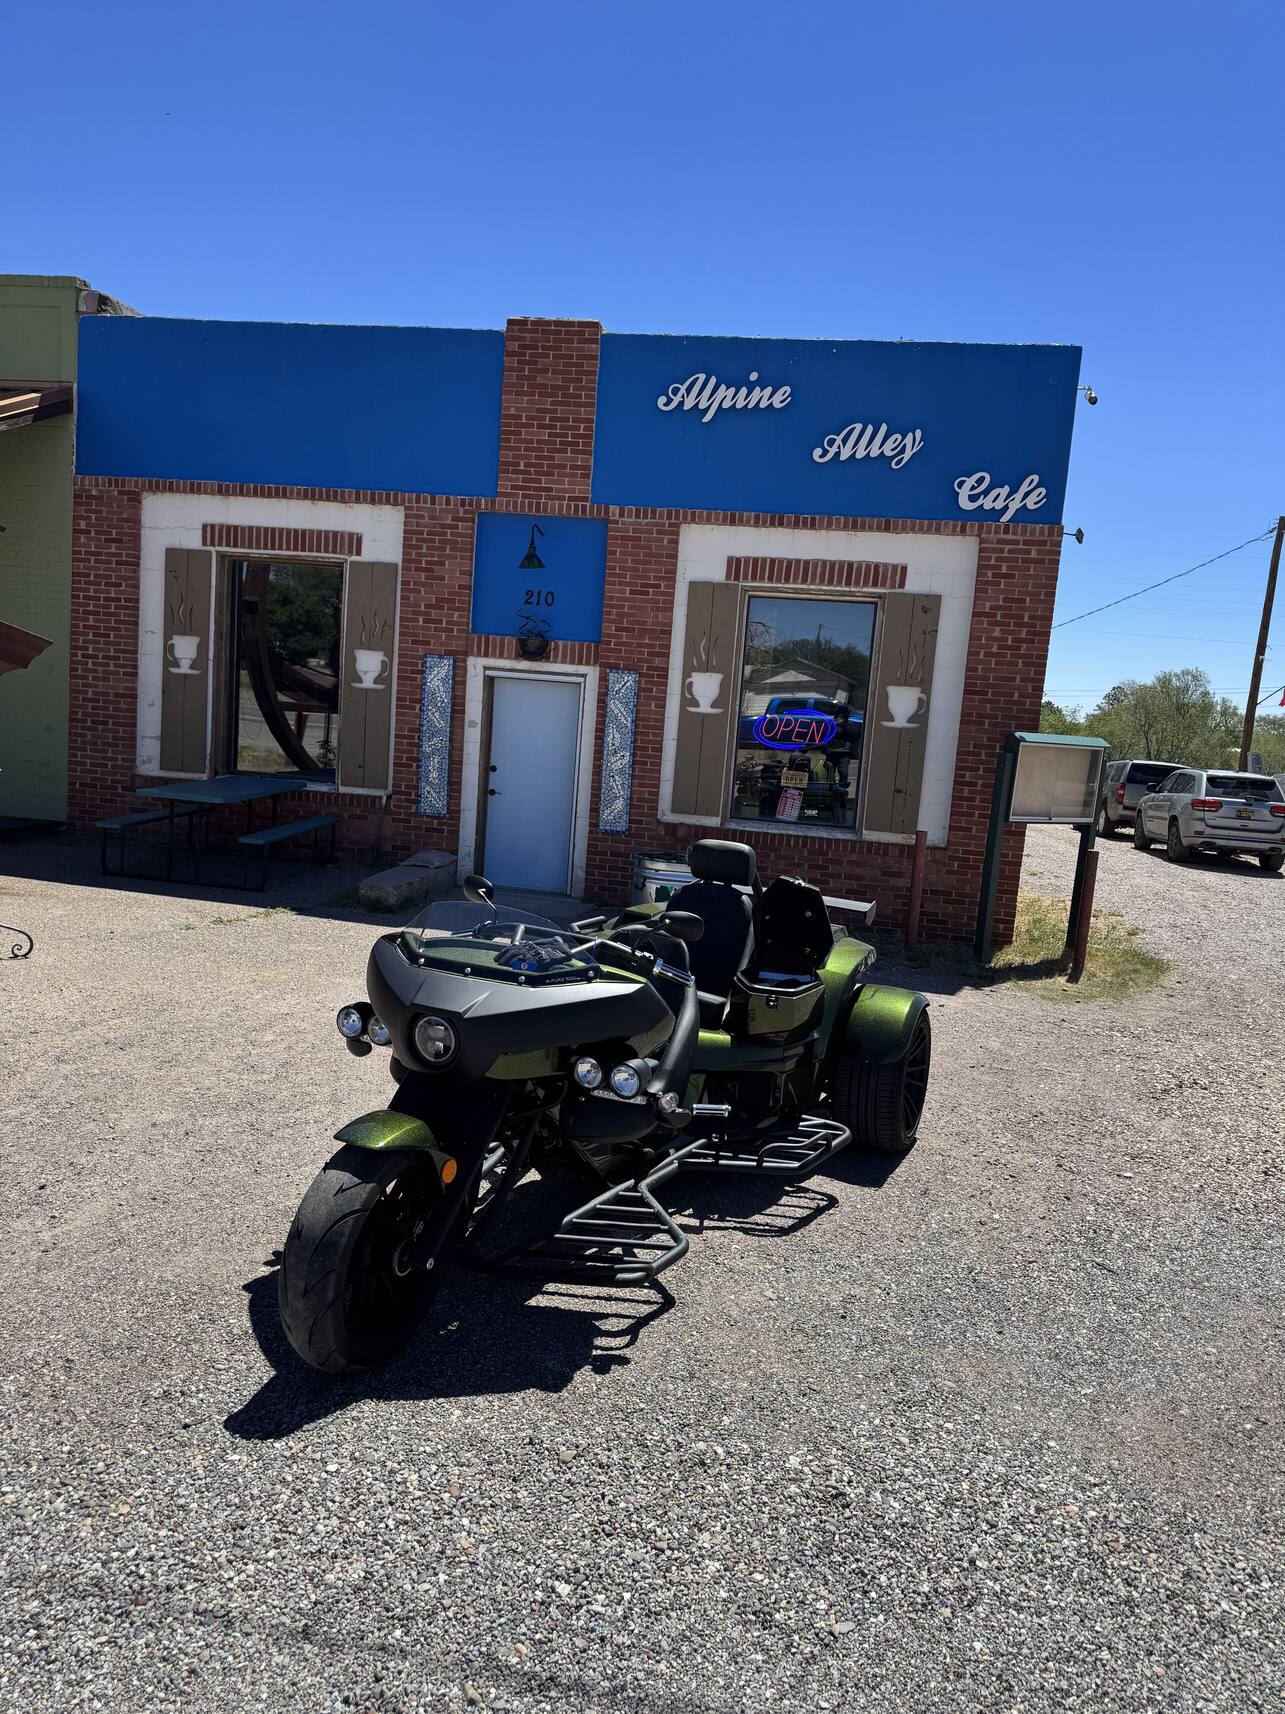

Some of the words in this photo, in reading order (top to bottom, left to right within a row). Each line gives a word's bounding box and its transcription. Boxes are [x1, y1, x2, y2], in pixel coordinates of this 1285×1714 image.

[657, 371, 792, 423] Alpine
[812, 422, 924, 469] Alley
[953, 471, 1047, 523] Cafe
[524, 589, 555, 607] 210
[762, 714, 825, 744] OPEN
